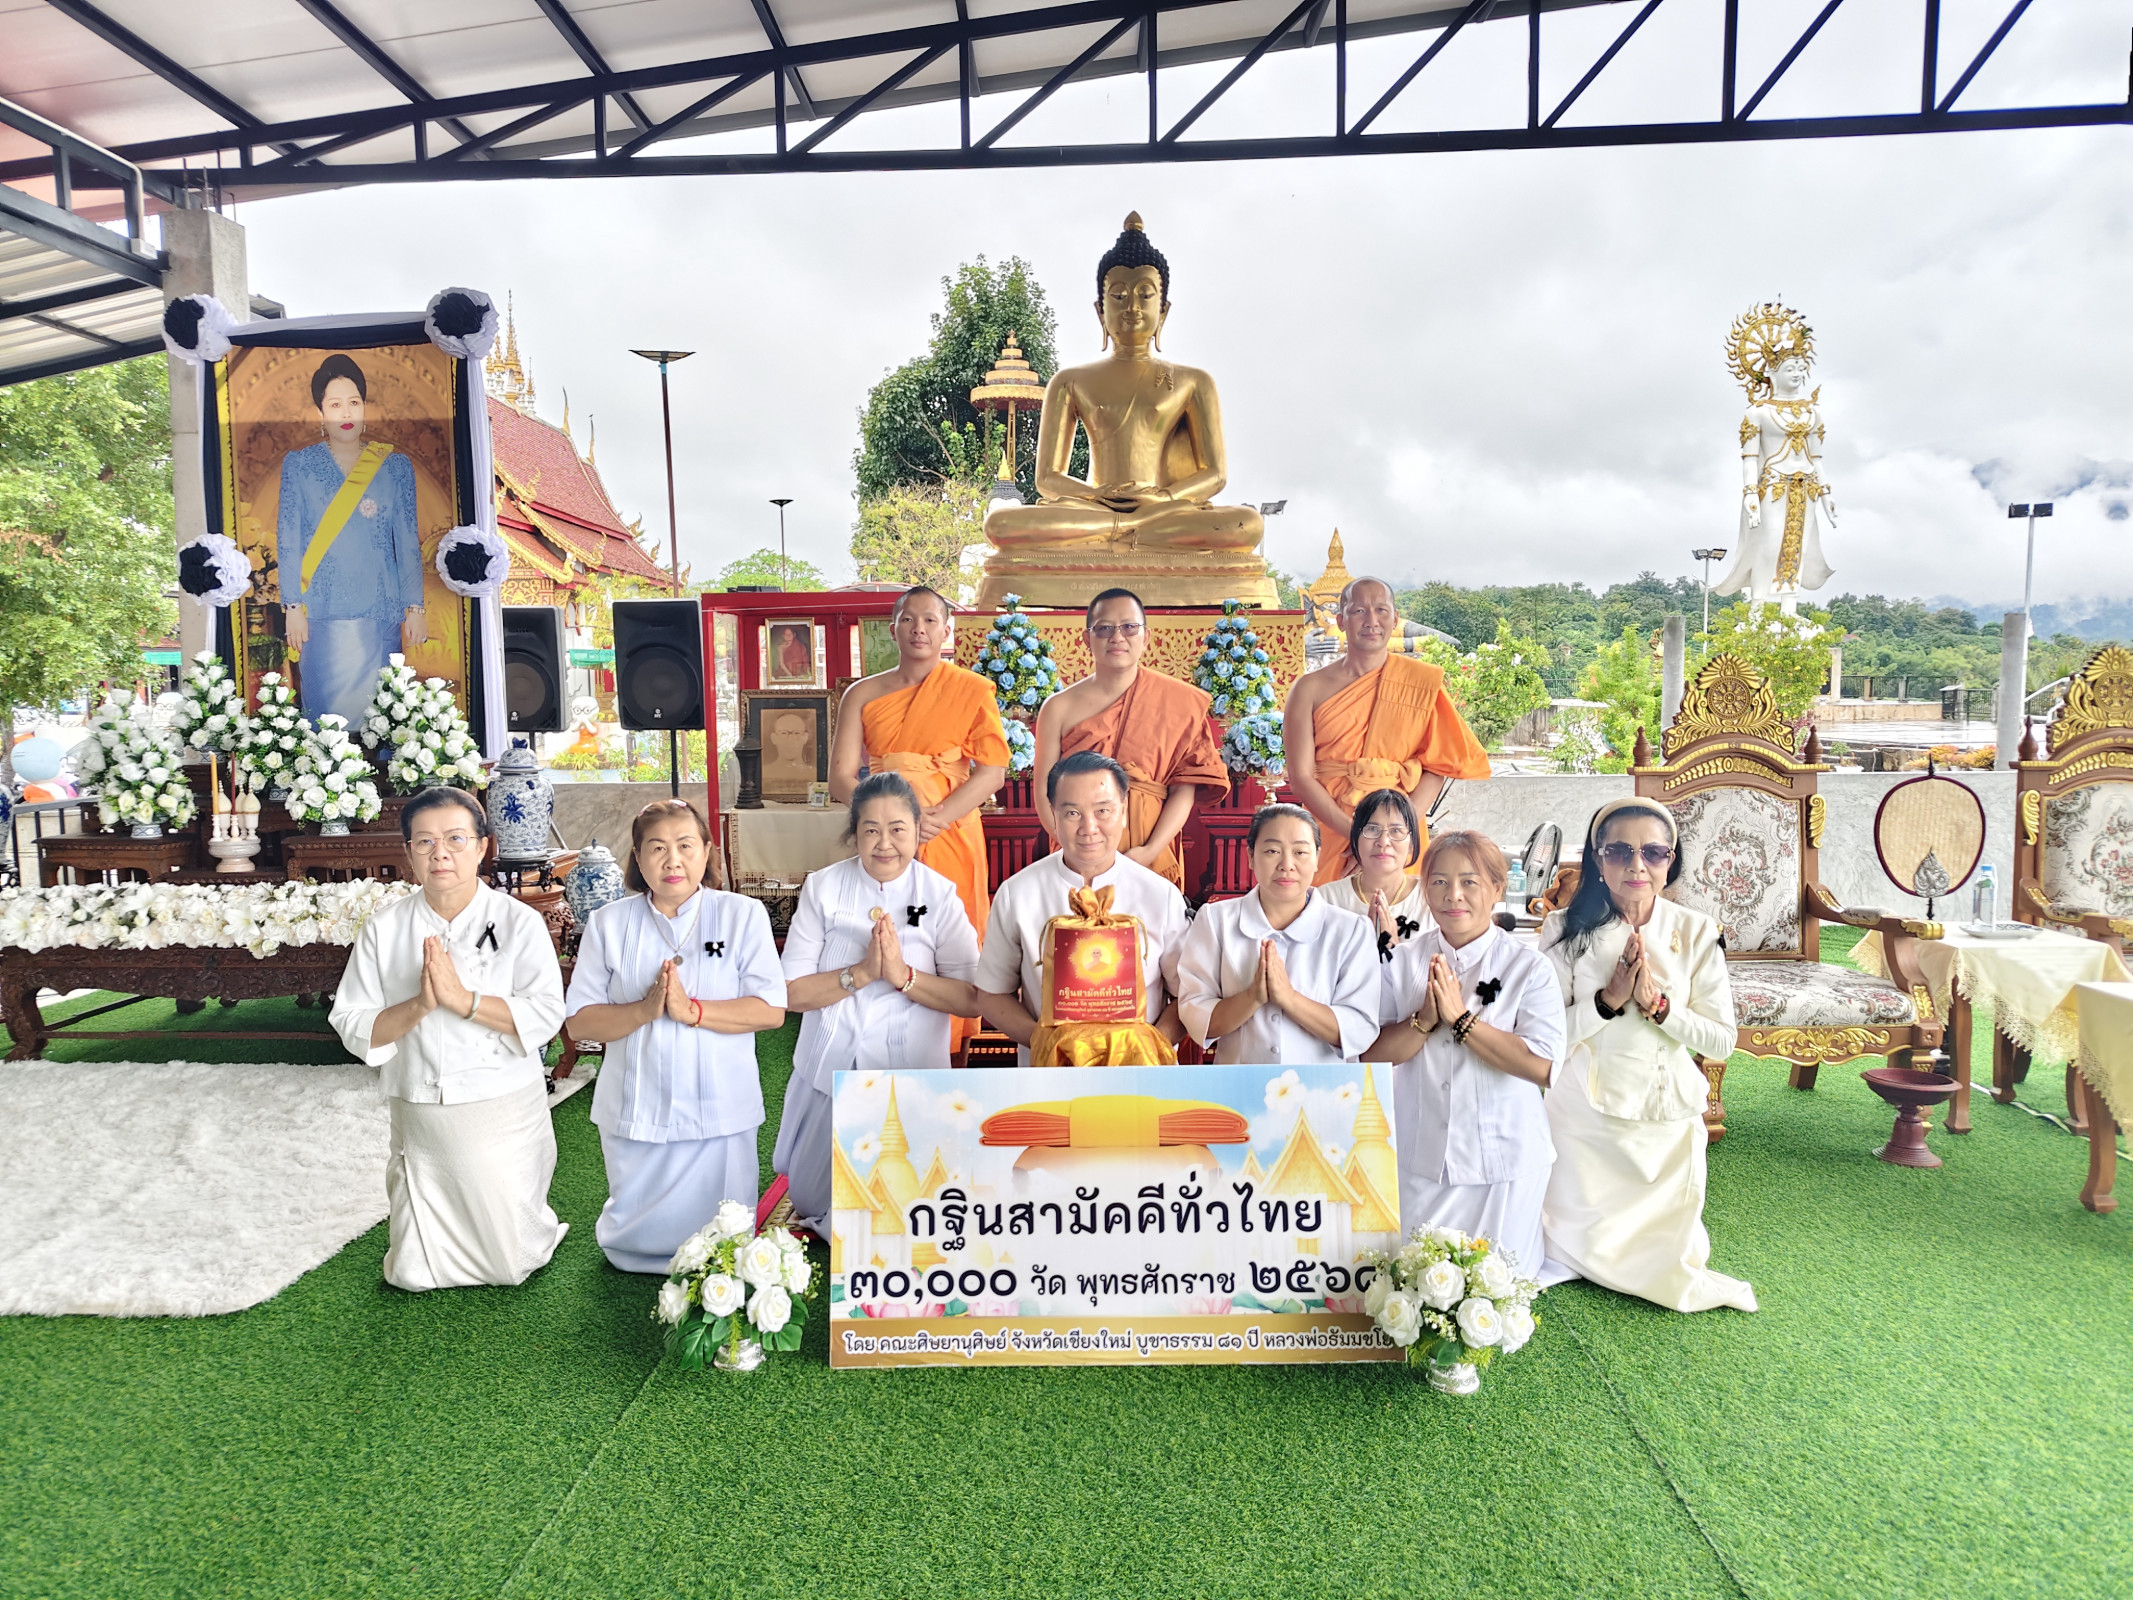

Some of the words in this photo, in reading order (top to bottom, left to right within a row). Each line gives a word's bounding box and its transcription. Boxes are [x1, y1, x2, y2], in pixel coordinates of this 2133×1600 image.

[908, 1170, 1322, 1251] กฐินสามัคคีทั่วไทย
[850, 1268, 1017, 1305] ๓๐,๐๐๐
[1030, 1264, 1067, 1296] วัด
[1076, 1263, 1236, 1308] พุทธศักราช
[844, 1332, 875, 1351] โดย
[880, 1329, 1007, 1357] คณะศิษยานุศิษย์
[1011, 1329, 1132, 1350] จังหวัดเชียงใหม่
[1136, 1334, 1213, 1356] บูชาธรรม
[1217, 1333, 1242, 1350] ๘๑
[1247, 1327, 1259, 1348] ปี
